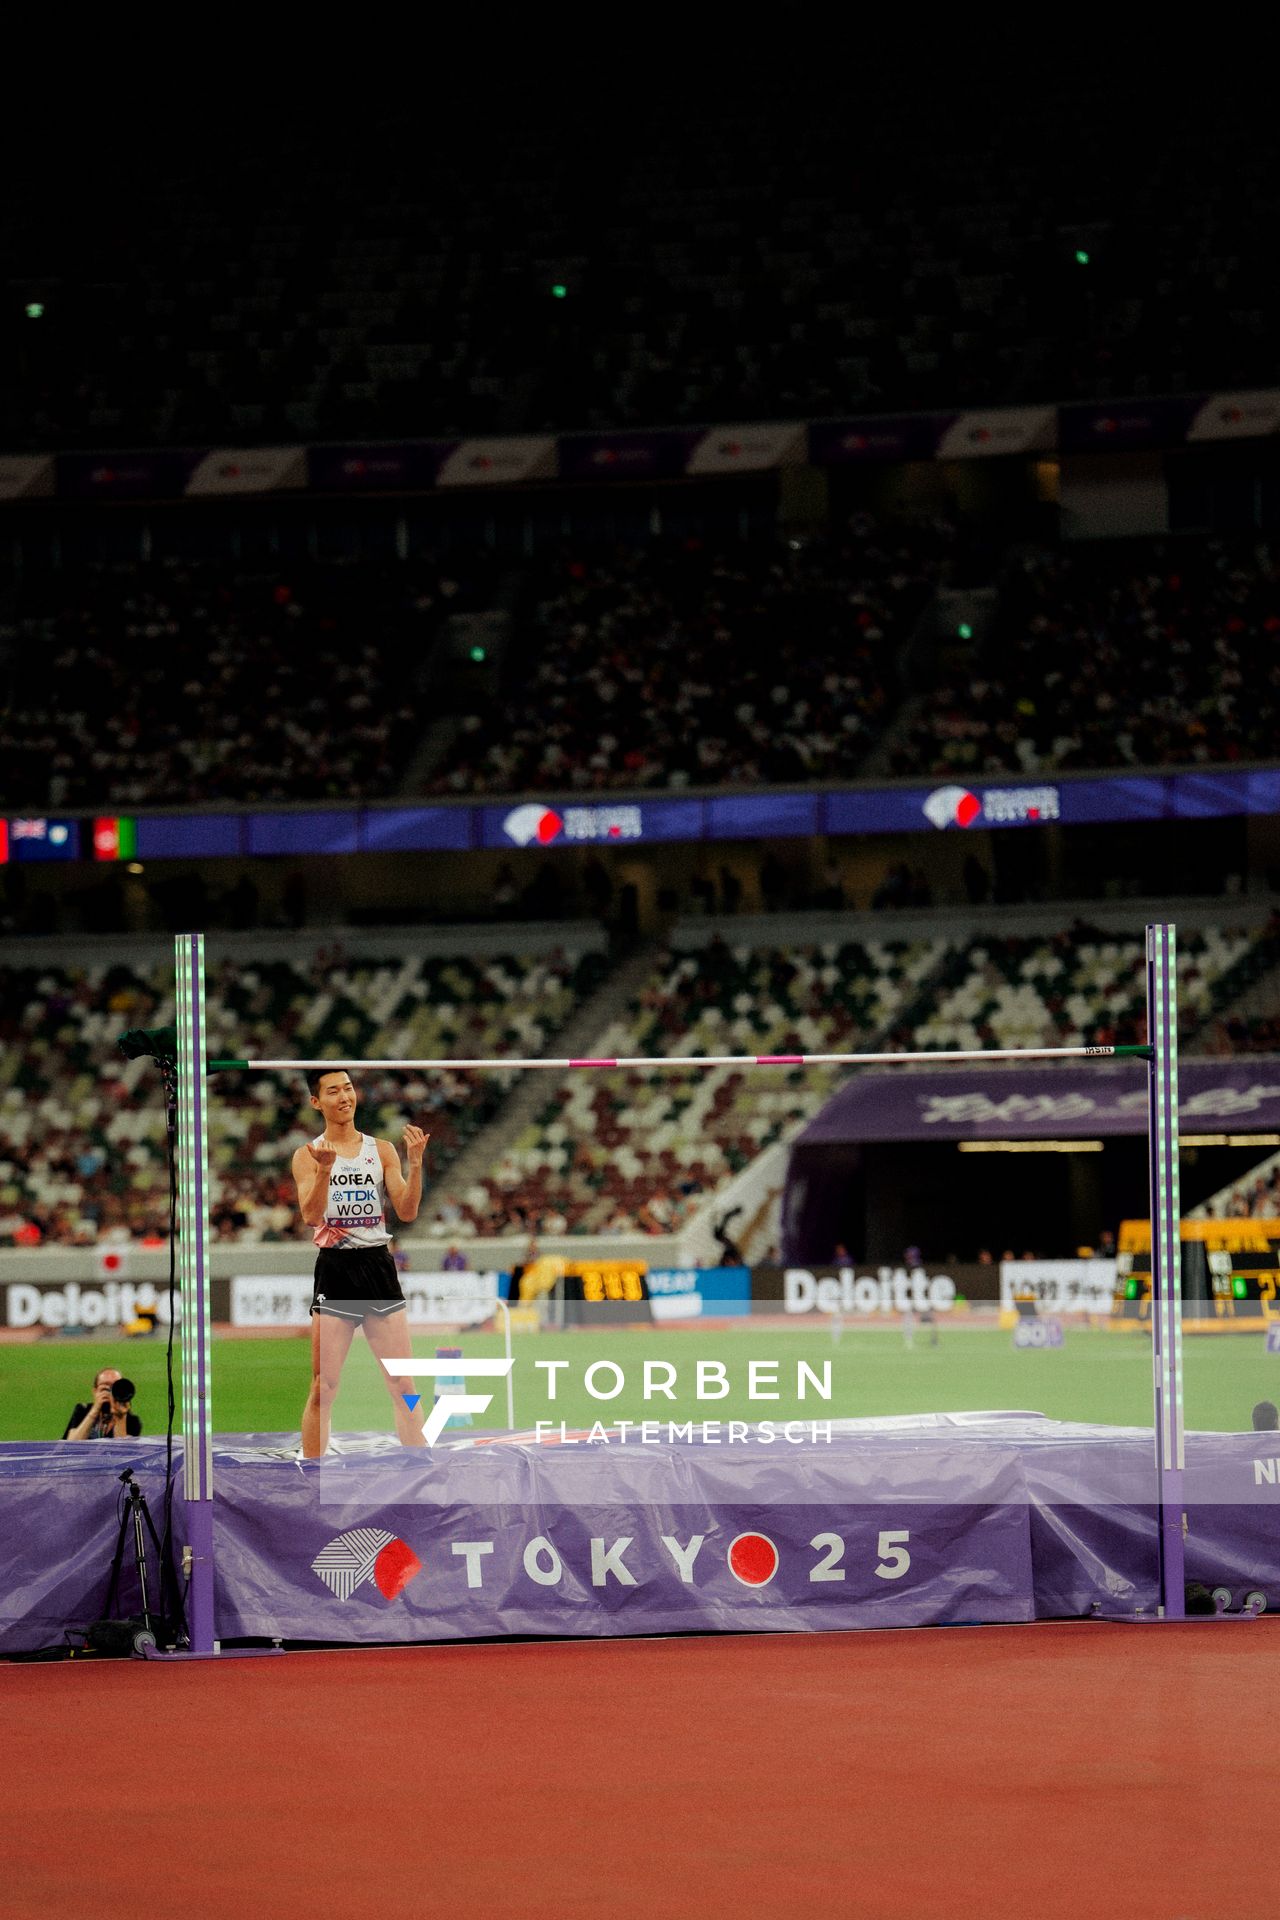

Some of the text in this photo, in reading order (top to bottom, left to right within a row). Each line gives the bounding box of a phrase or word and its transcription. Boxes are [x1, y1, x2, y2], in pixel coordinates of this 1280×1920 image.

[330, 1174, 375, 1186] KOREA
[343, 1190, 376, 1201] TDK
[337, 1204, 374, 1216] WOO
[784, 1266, 956, 1313] Deloitte
